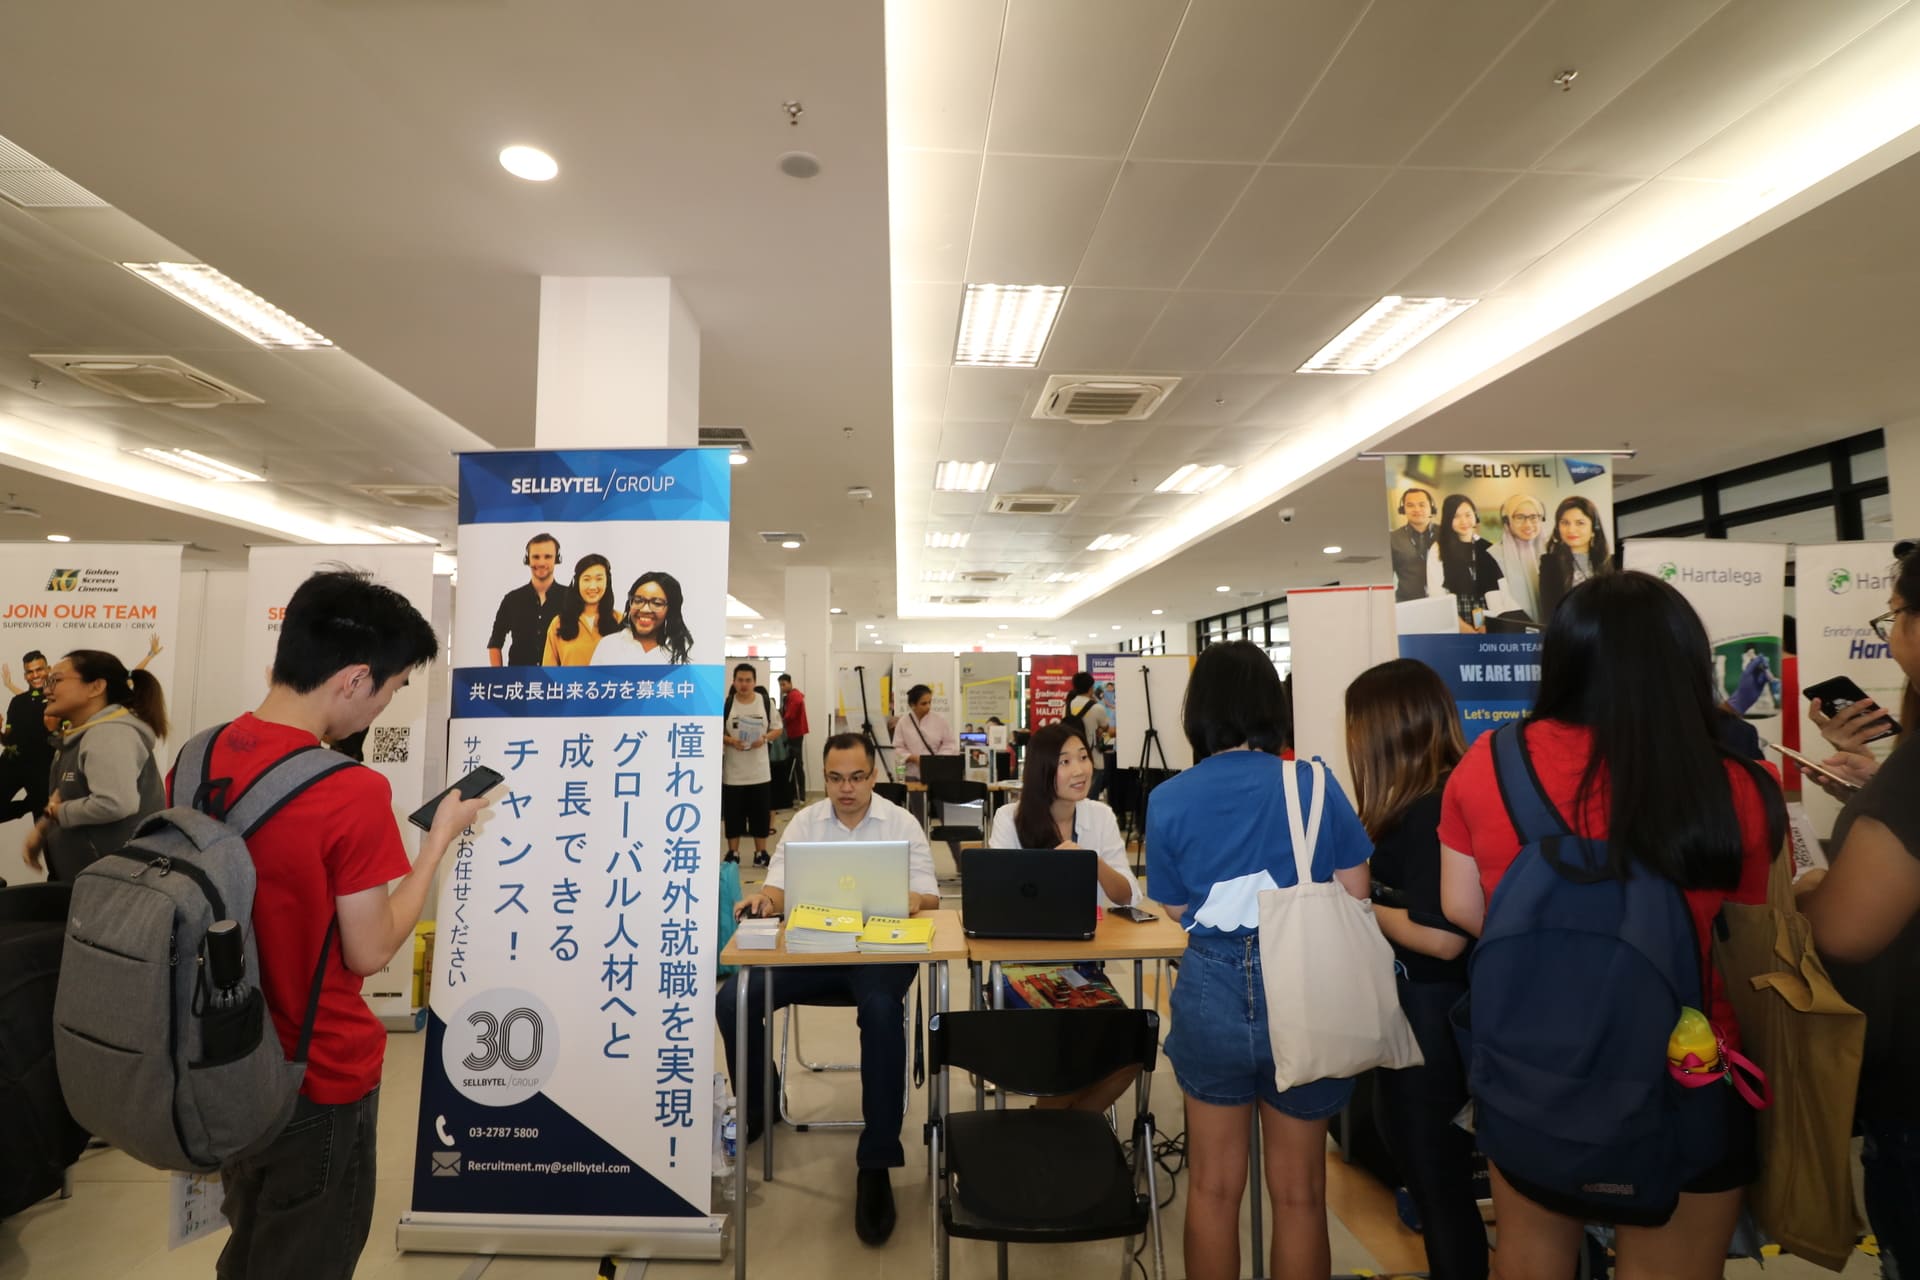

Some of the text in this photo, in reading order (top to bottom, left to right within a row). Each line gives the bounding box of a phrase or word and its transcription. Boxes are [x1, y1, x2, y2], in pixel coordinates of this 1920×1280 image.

[1463, 464, 1551, 479] SELLBYTEL
[511, 476, 675, 495] SELLBYTEL GROUP
[1681, 567, 1762, 586] Hartalega
[1856, 573, 1894, 589] Har
[2, 604, 158, 619] JOIN OUR TEAM
[1478, 643, 1498, 653] JOIN
[1499, 643, 1519, 652] OUR
[1459, 664, 1542, 682] WE ARE HIR
[469, 680, 695, 701] 共に成長出来る方を募集中
[1464, 709, 1491, 720] Let's
[1492, 711, 1520, 722] grow
[550, 732, 595, 962] 成長できる
[600, 730, 648, 1059] グローバル人材へと
[462, 1007, 544, 1072] 30
[463, 1077, 540, 1087] SELLBYTEL GROUP
[469, 1127, 539, 1138] 03-2787 5800
[468, 1160, 631, 1174] Recruitment.my@sellbytel.com
